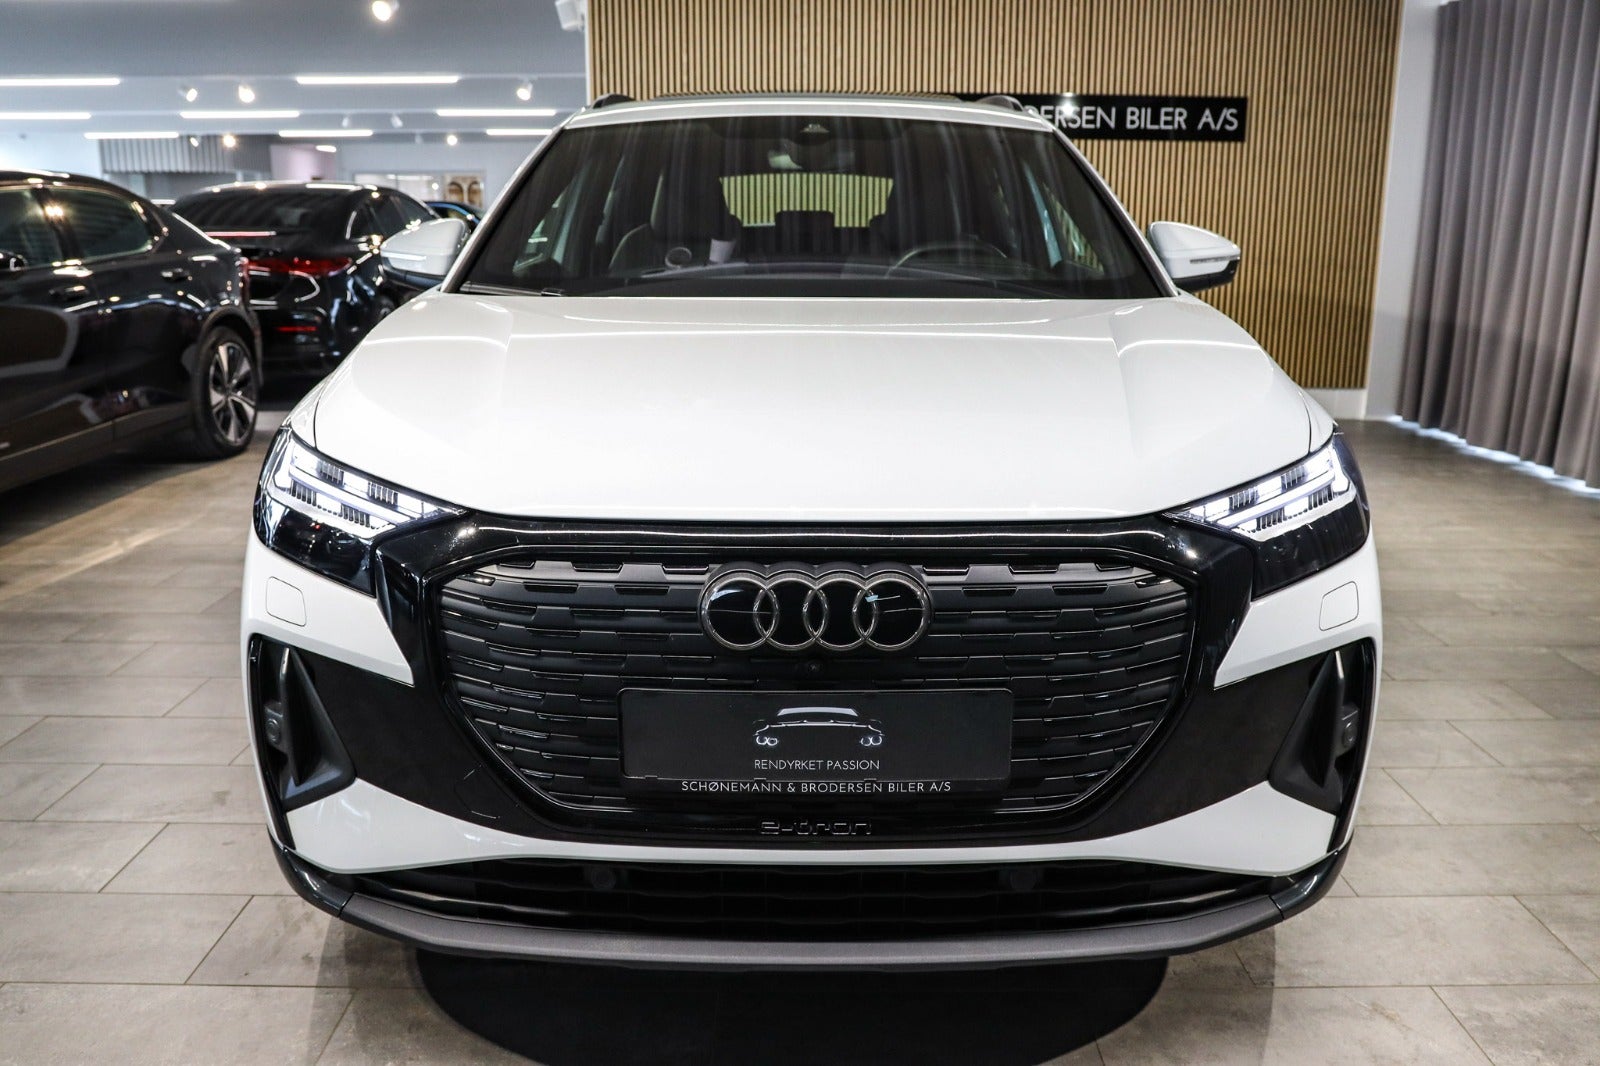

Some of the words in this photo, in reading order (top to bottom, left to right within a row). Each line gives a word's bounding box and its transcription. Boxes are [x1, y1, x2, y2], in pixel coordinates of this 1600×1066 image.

[1126, 106, 1188, 130] BILER
[1197, 107, 1239, 131] A/S
[754, 759, 824, 771] RENDYRKET
[826, 759, 880, 771] PASSION
[681, 780, 782, 793] SCHØNEMANN
[786, 782, 796, 793] &
[801, 782, 883, 793] BRODERSEN
[888, 782, 925, 793] BILER
[929, 781, 951, 793] A/S
